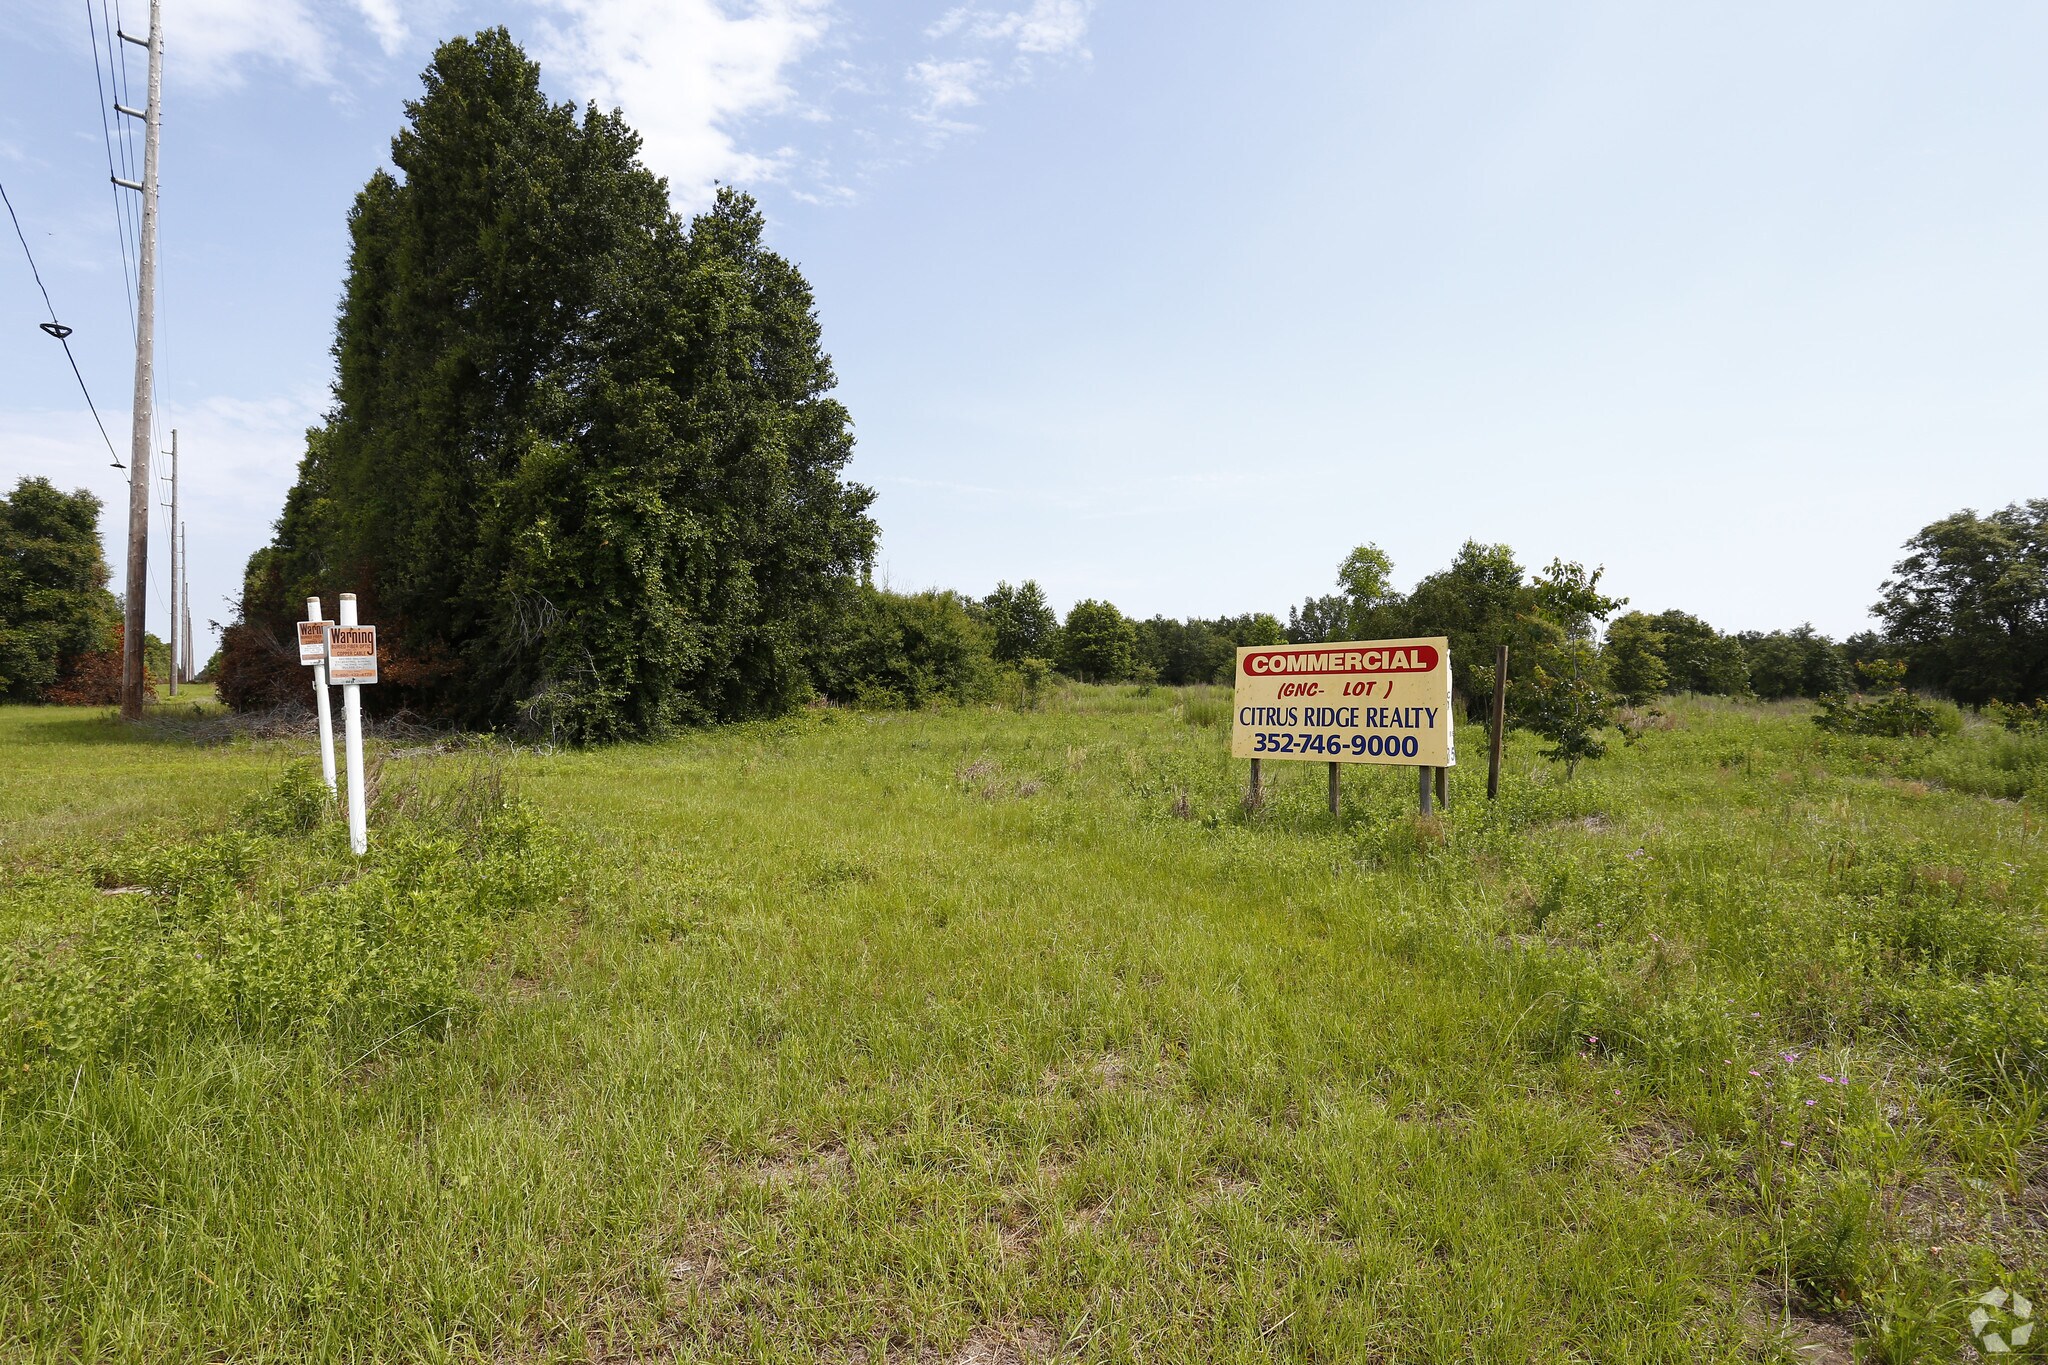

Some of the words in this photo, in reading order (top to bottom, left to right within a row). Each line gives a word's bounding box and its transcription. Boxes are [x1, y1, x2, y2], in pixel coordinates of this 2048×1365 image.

[299, 624, 324, 635] Warni
[331, 628, 374, 656] Warning
[1251, 649, 1427, 674] COMMERCIAL
[1343, 681, 1377, 697] LOT
[1240, 706, 1298, 727] CITRUS
[1304, 707, 1360, 728] RIDGE
[1366, 707, 1439, 729] REALTY
[1253, 733, 1419, 758] 352-746-9000
